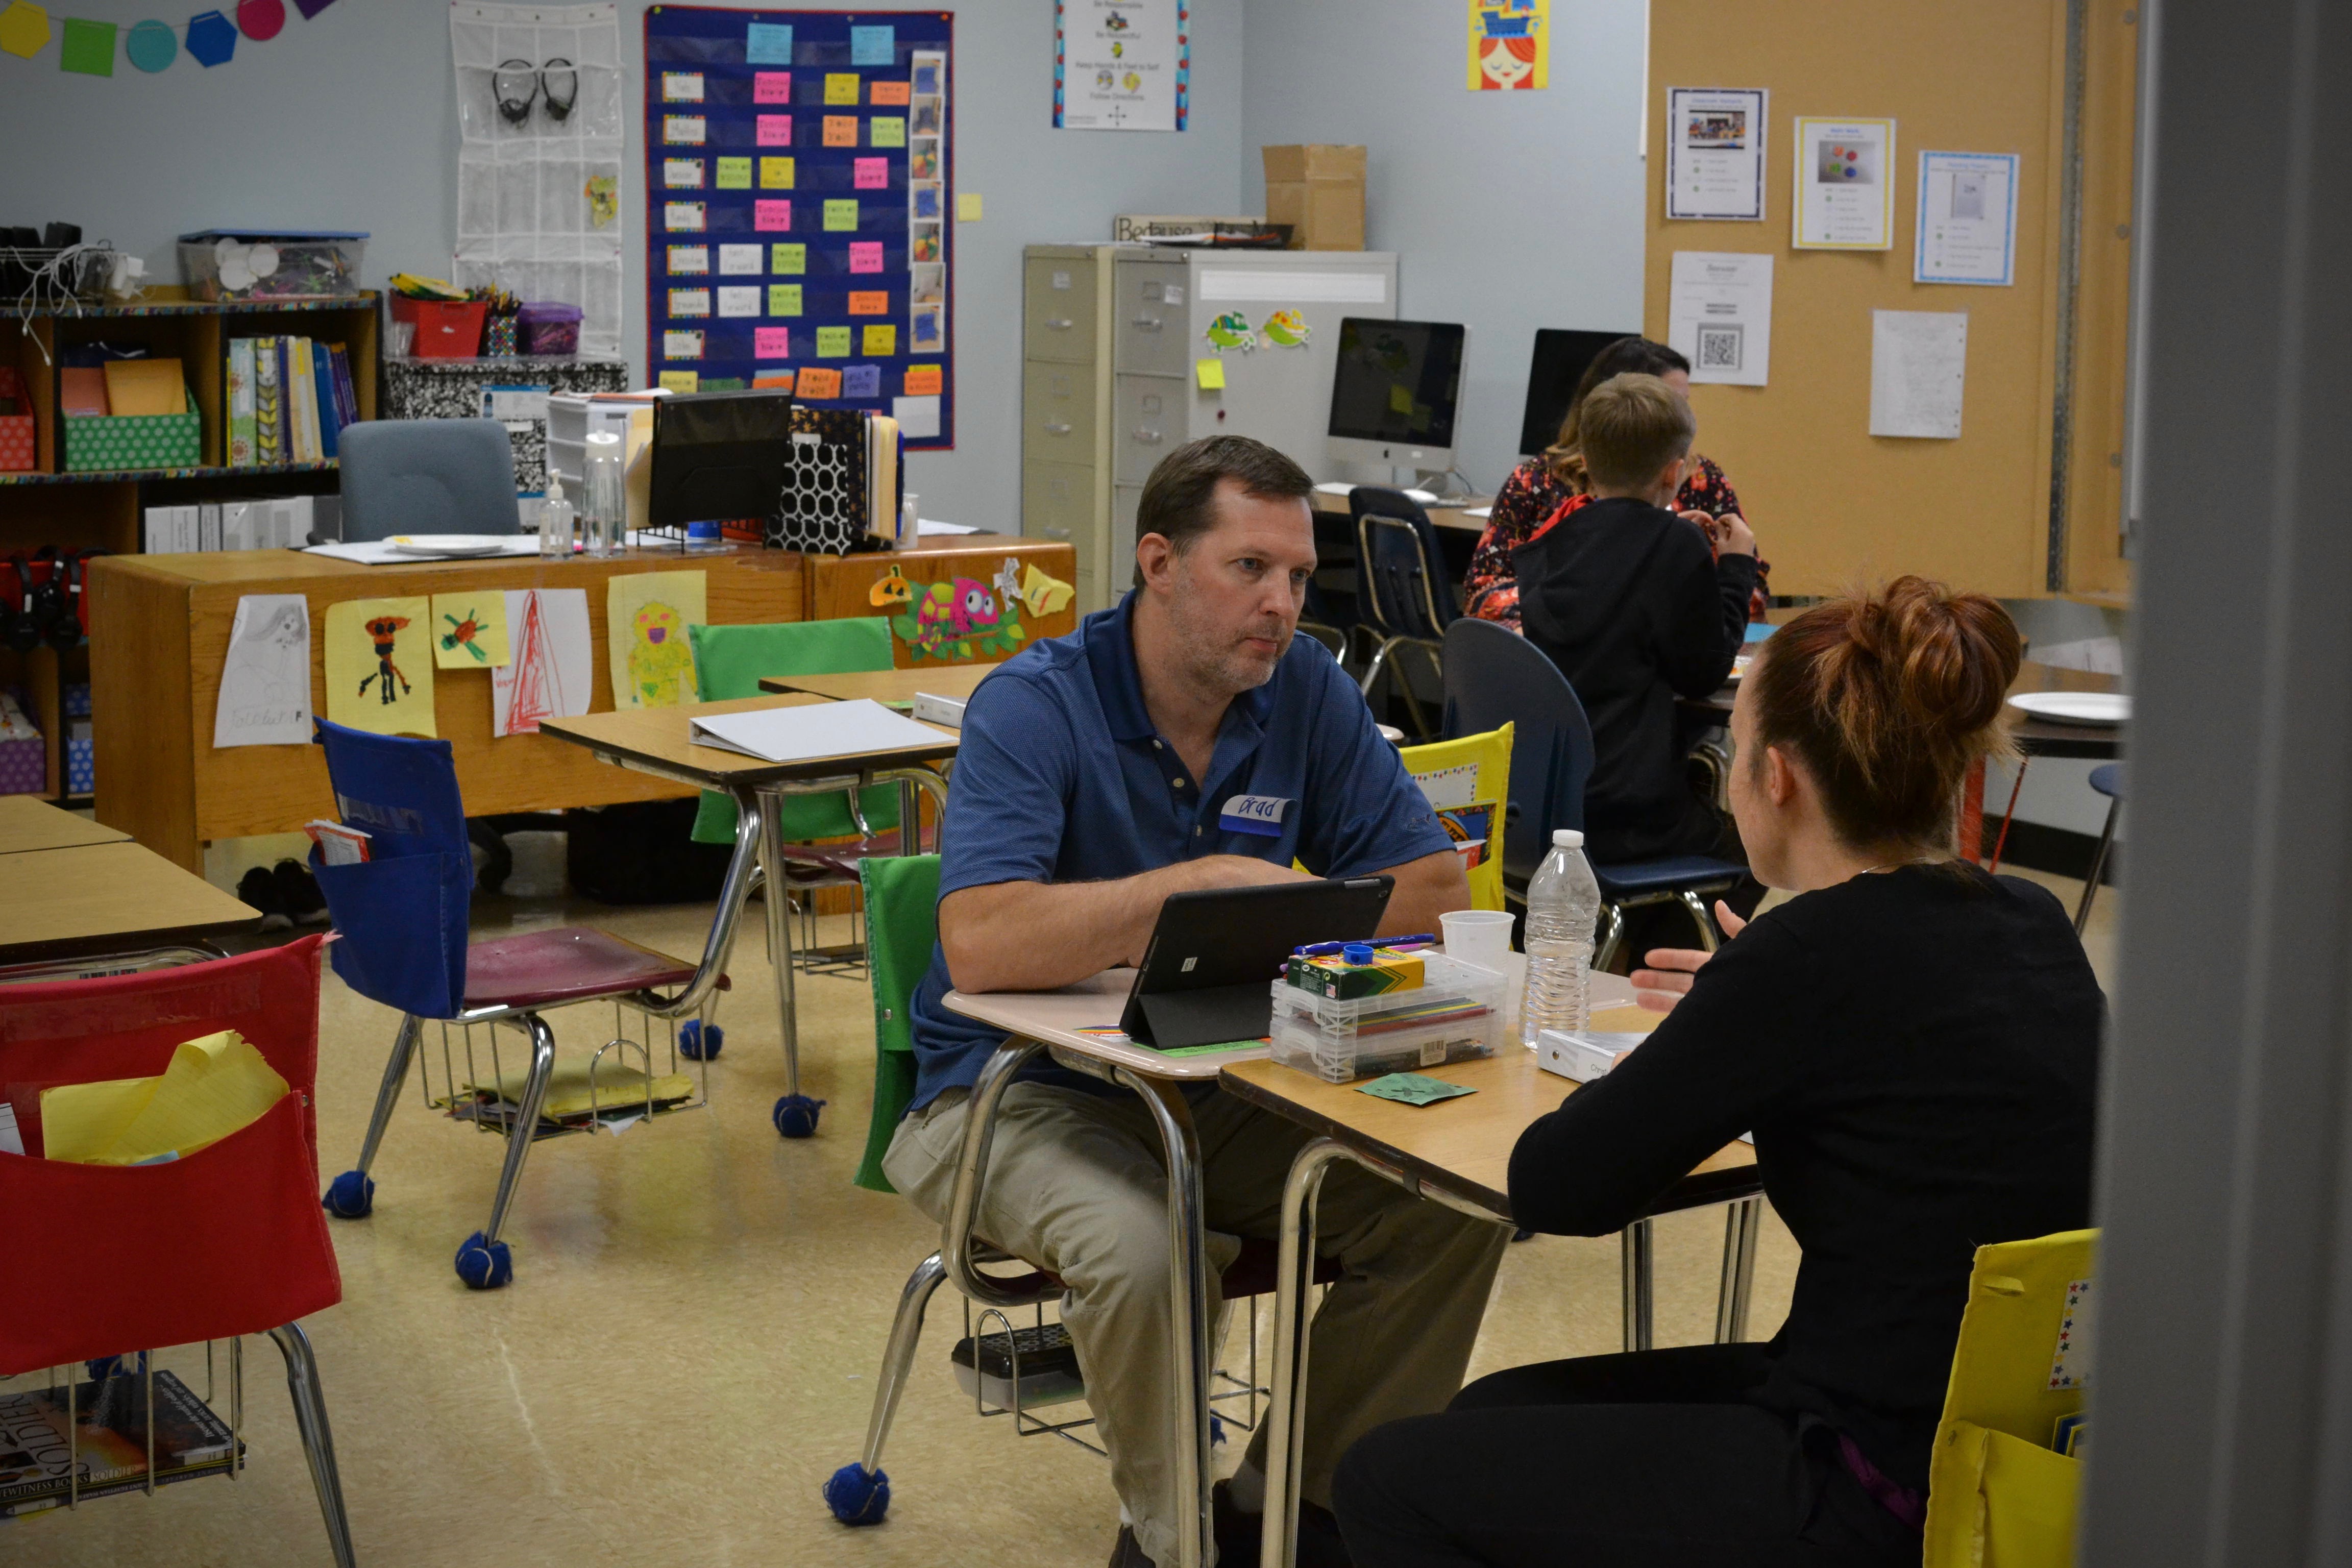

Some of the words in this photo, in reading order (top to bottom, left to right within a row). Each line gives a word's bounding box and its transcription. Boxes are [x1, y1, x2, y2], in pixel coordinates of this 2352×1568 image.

[1238, 797, 1281, 817] Brad
[93, 1466, 136, 1481] SOLDIER
[0, 1479, 52, 1497] YEWITNESS
